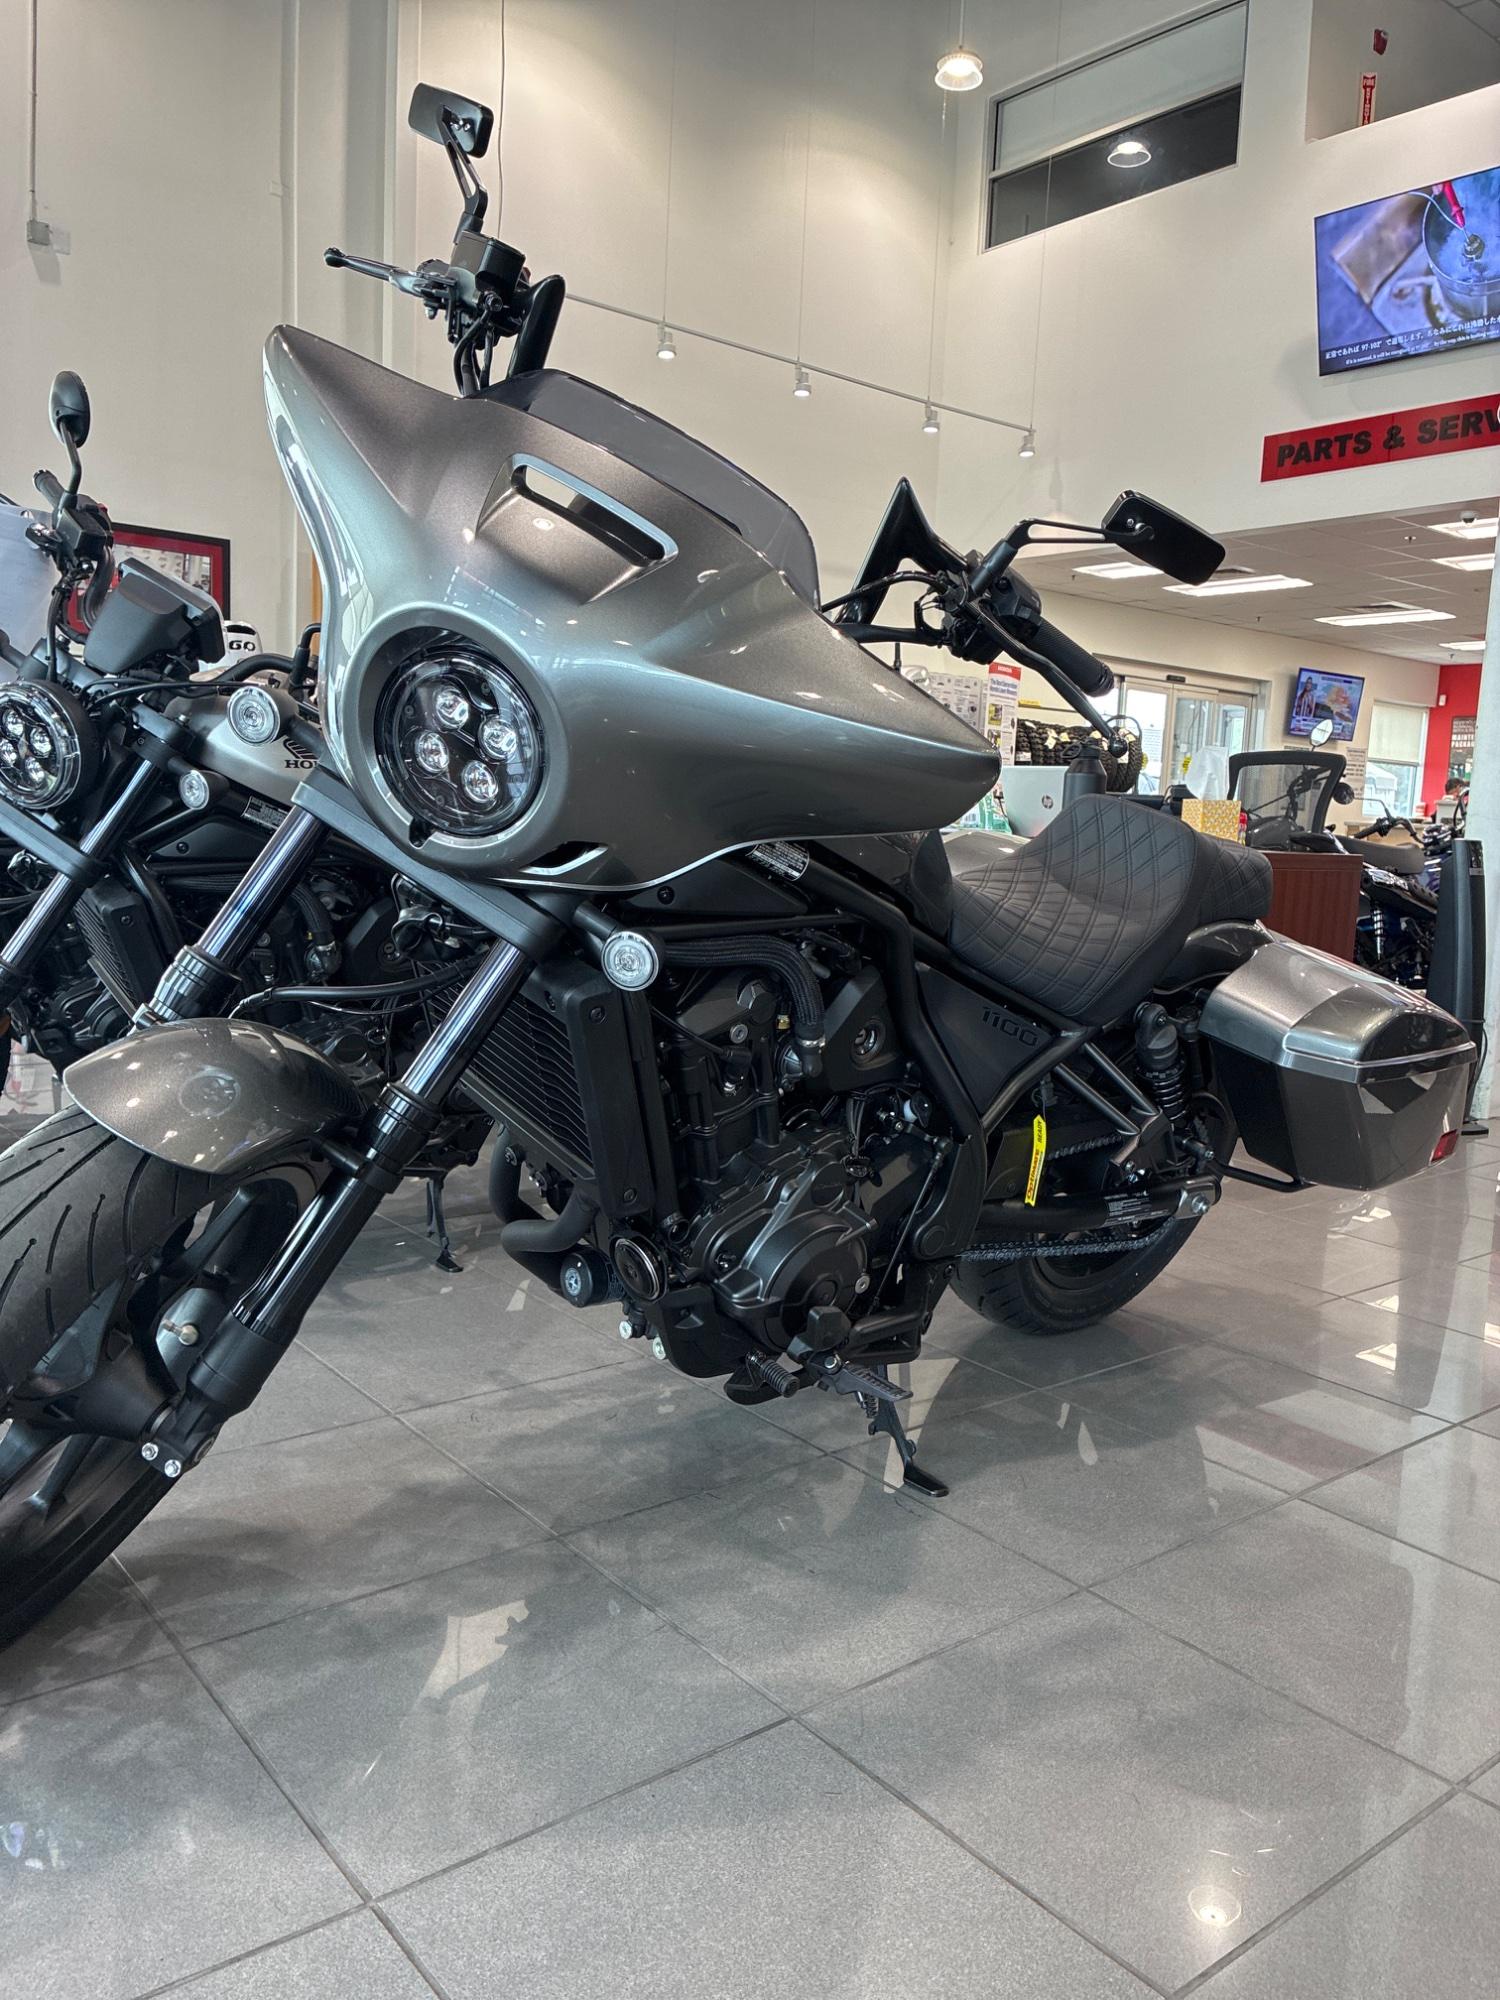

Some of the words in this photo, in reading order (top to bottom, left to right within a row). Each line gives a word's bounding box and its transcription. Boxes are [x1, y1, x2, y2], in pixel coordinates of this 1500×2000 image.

[1277, 430, 1372, 468] PARTS
[1383, 425, 1405, 450] &
[982, 1006, 1038, 1046] 1100
